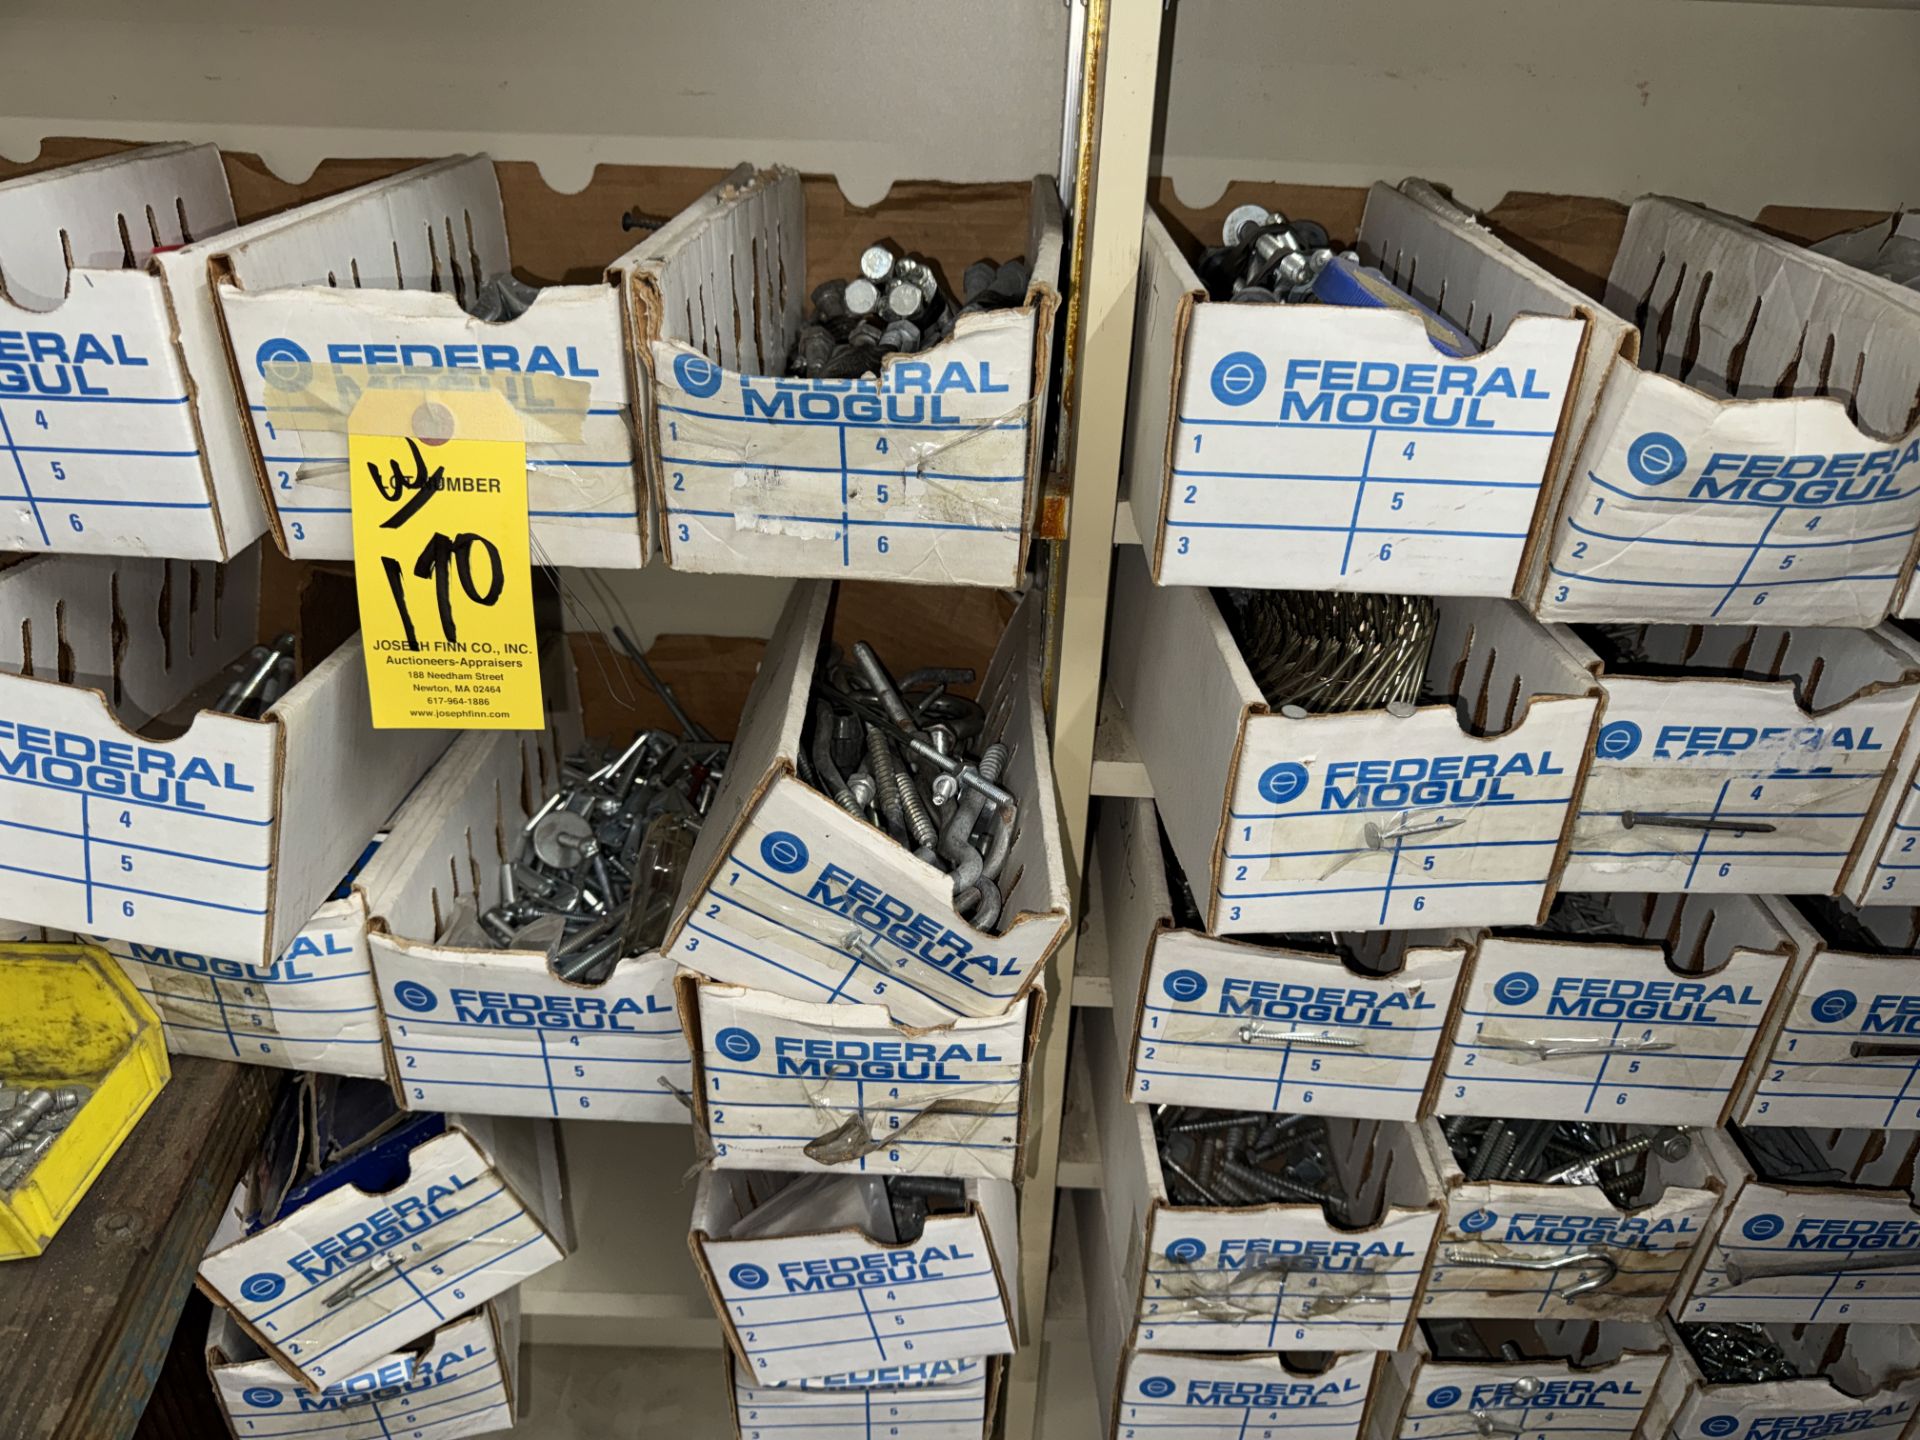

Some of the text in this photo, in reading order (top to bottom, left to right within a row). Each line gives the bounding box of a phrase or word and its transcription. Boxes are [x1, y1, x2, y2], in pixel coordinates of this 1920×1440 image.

[327, 344, 599, 377] FEDERAL
[1284, 360, 1550, 399] FEDERAL
[741, 390, 960, 424] MOGUL
[1279, 391, 1495, 428] MOGUL
[36, 410, 48, 429] 4
[265, 421, 276, 440] 1
[669, 422, 677, 441] 1
[876, 437, 888, 454] 4
[1194, 435, 1202, 453] 1
[1403, 442, 1415, 460] 4
[51, 462, 65, 480] 5
[278, 471, 292, 489] 2
[425, 476, 500, 493] UMBER
[673, 473, 684, 491] 2
[877, 485, 888, 503] 5
[1184, 486, 1197, 503] 2
[1688, 473, 1903, 503] MOGUL
[1391, 492, 1404, 510] 5
[1594, 498, 1604, 515] 1
[69, 514, 83, 532] 6
[1806, 516, 1821, 531] 4
[292, 522, 304, 540] 3
[678, 524, 689, 542] 3
[878, 536, 888, 553] 6
[1178, 537, 1189, 554] 3
[1572, 542, 1587, 559] 2
[1380, 544, 1392, 561] 6
[1779, 555, 1795, 569] 5
[381, 533, 504, 651] 170
[1555, 586, 1569, 602] 3
[1753, 592, 1768, 605] 6
[373, 640, 429, 652] JOSEH
[435, 642, 466, 652] FINN
[505, 644, 532, 654] INC.
[386, 656, 522, 668] Auctioneers-Appraisers
[428, 672, 472, 680] Needham
[413, 684, 452, 693] Newton,
[427, 697, 490, 705] 617-964-1886
[410, 710, 509, 719] www.josephfinn.com
[1325, 752, 1564, 786] FEDERAL
[0, 747, 205, 810] MOGUL
[1321, 778, 1515, 809] MOGUL
[1751, 786, 1763, 800] 4
[120, 811, 131, 828] 4
[1244, 826, 1251, 841] 1
[1901, 837, 1916, 852] 2
[121, 855, 132, 871] 5
[1423, 856, 1434, 870] 5
[1719, 863, 1731, 877] 6
[730, 873, 739, 886] 1
[1236, 866, 1247, 880] 2
[1882, 876, 1896, 890] 3
[123, 901, 134, 917] 6
[1414, 896, 1425, 911] 6
[706, 904, 720, 919] 2
[1230, 907, 1240, 920] 3
[818, 863, 1022, 976] FEDERAL
[807, 880, 976, 983] MOGUL
[686, 938, 699, 951] 3
[874, 982, 887, 994] 5
[1222, 978, 1436, 1010] FEDERAL
[1552, 977, 1763, 1005] FEDERAL
[450, 989, 673, 1014] FEDERAL
[1219, 995, 1392, 1026] MOGUL
[1547, 997, 1717, 1022] MOGUL
[252, 1015, 262, 1026] 5
[456, 1006, 635, 1030] MOGUL
[1152, 1017, 1158, 1028] 1
[398, 1026, 406, 1036] 1
[1477, 1022, 1484, 1034] 1
[570, 1035, 579, 1046] 4
[1789, 1039, 1797, 1051] 1
[260, 1044, 271, 1053] 6
[775, 1037, 1002, 1062] FEDERAL
[1145, 1048, 1155, 1059] 2
[406, 1056, 416, 1067] 2
[1311, 1059, 1320, 1071] 5
[1465, 1054, 1476, 1065] 2
[575, 1066, 584, 1077] 5
[777, 1056, 960, 1080] MOGUL
[1629, 1061, 1640, 1073] 5
[1772, 1070, 1784, 1081] 2
[712, 1078, 719, 1090] 1
[1141, 1080, 1149, 1091] 3
[414, 1088, 424, 1099] 3
[889, 1088, 898, 1099] 4
[1303, 1091, 1312, 1102] 6
[1455, 1086, 1465, 1098] 3
[1617, 1093, 1627, 1104] 6
[580, 1097, 589, 1108] 6
[1758, 1102, 1769, 1113] 3
[714, 1111, 724, 1123] 2
[890, 1116, 899, 1129] 5
[718, 1145, 727, 1156] 3
[890, 1149, 899, 1161] 6
[288, 1174, 478, 1281] FEDERAL
[1510, 1213, 1698, 1233] FEDERAL
[302, 1204, 458, 1285] MOGUL
[1505, 1227, 1659, 1248] MOGUL
[412, 1242, 422, 1251] 4
[1219, 1239, 1414, 1257] FEDERAL
[778, 1245, 973, 1276] FEDERAL
[1218, 1255, 1376, 1272] MGUL
[431, 1265, 444, 1275] 5
[786, 1264, 943, 1292] MOGUL
[1707, 1278, 1719, 1287] 2
[1855, 1280, 1866, 1290] 5
[453, 1289, 465, 1299] 6
[887, 1291, 895, 1300] 4
[737, 1306, 744, 1316] 1
[1696, 1303, 1706, 1312] 3
[1840, 1304, 1849, 1313] 6
[266, 1322, 277, 1331] 1
[895, 1316, 904, 1325] 5
[747, 1332, 756, 1342] 2
[1145, 1330, 1153, 1339] 3
[1296, 1329, 1304, 1339] 6
[289, 1344, 302, 1354] 2
[904, 1341, 913, 1349] 6
[758, 1358, 767, 1367] 3
[313, 1366, 325, 1376] 3
[1188, 1378, 1360, 1395] FEDERAL
[1186, 1393, 1328, 1406] MOGUL
[1469, 1393, 1605, 1409] MOGUL
[750, 1411, 757, 1419] 2
[1751, 1402, 1910, 1429] FEDERAL
[1126, 1430, 1134, 1438] 2
